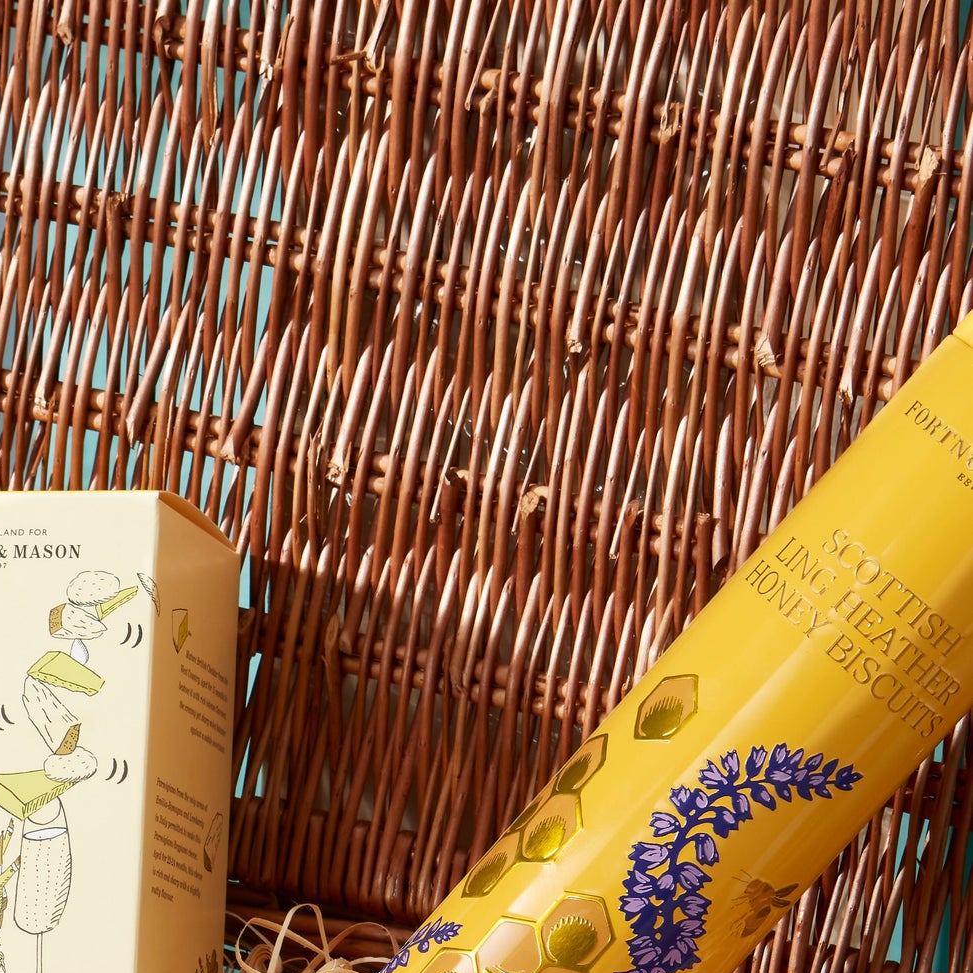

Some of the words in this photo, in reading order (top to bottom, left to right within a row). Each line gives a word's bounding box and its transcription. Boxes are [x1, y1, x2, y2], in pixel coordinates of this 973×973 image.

[13, 544, 81, 559] MASON
[28, 529, 48, 537] FOR
[822, 528, 966, 658] SCOTTISH
[745, 559, 831, 639] HONEY
[825, 631, 944, 738] BISCUITS
[775, 537, 836, 597] LING
[831, 588, 961, 707] HEATHER
